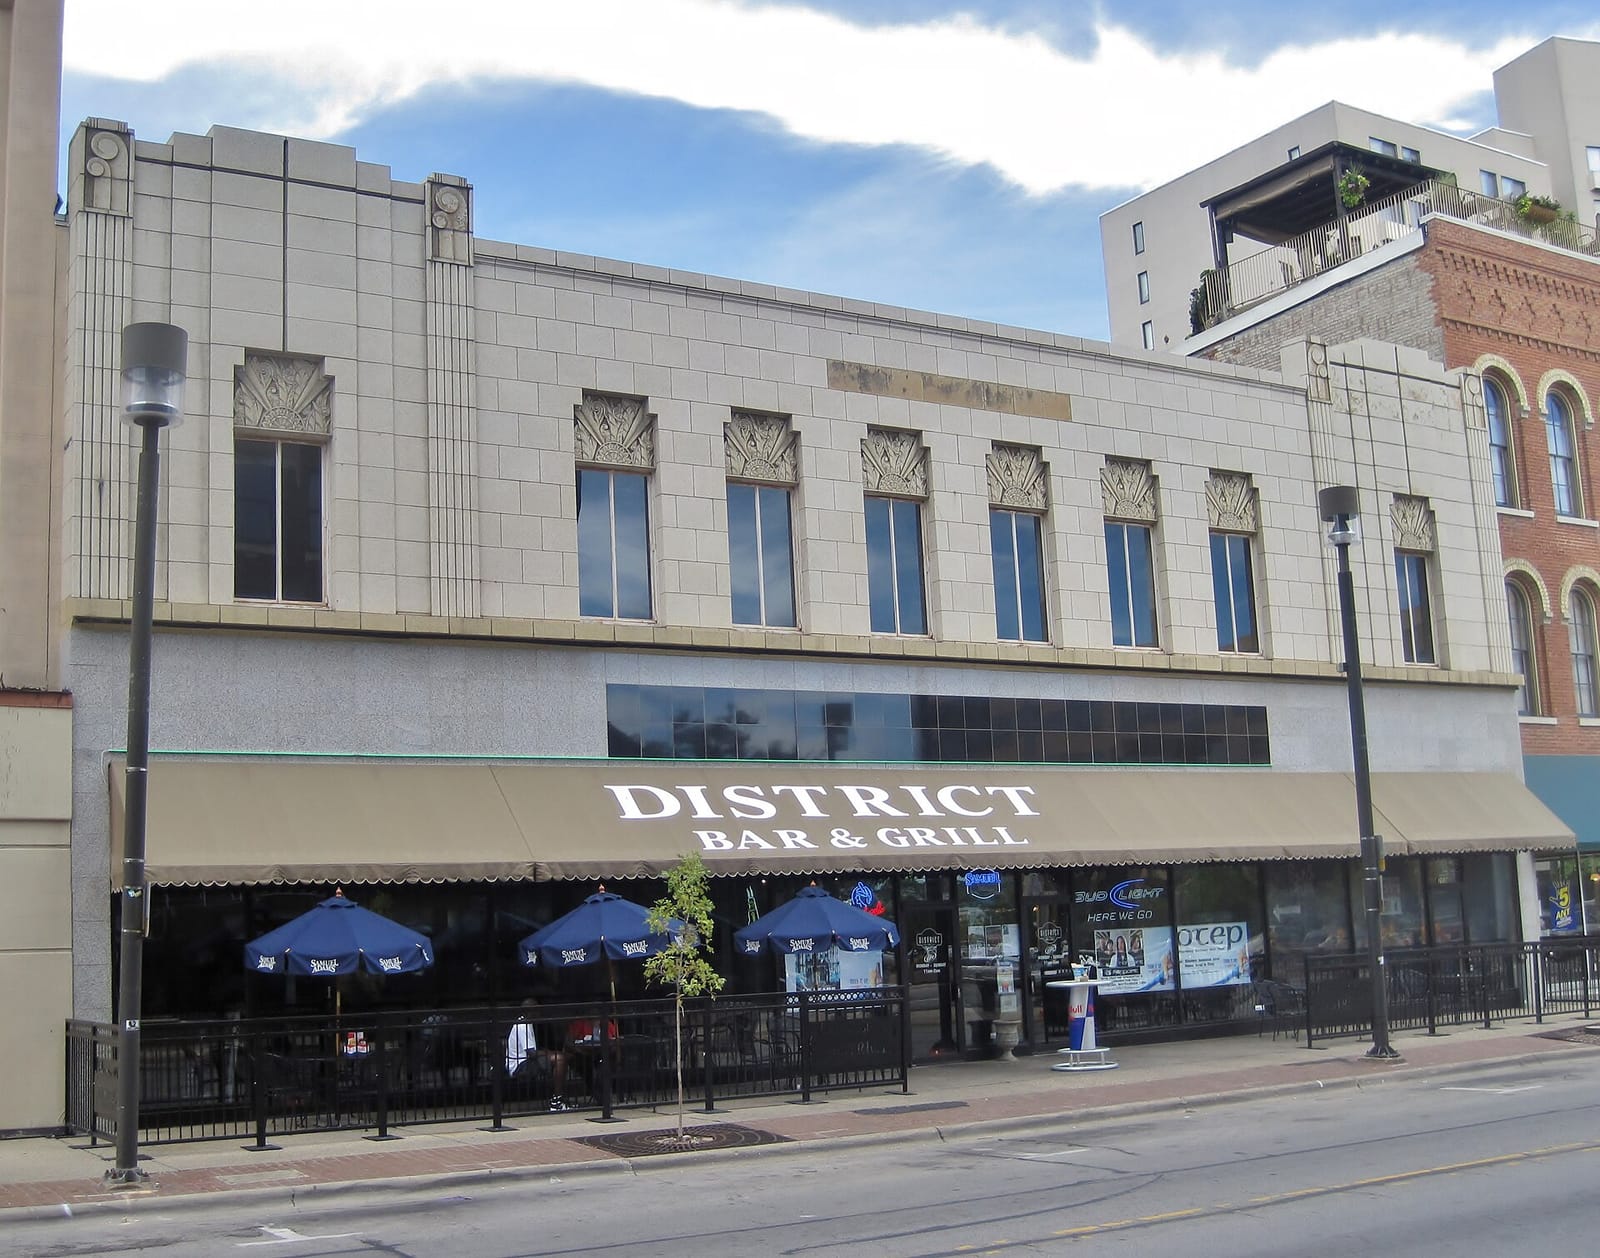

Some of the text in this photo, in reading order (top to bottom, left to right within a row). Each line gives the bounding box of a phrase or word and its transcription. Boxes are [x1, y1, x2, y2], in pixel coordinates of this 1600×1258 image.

[603, 784, 1041, 820] DISTRICT
[692, 826, 1030, 851] BAR & GRILL
[1075, 887, 1164, 904] BUD LIGHT
[1559, 886, 1570, 907] 5
[1087, 909, 1153, 923] HERE WE GO
[790, 938, 815, 948] SAMUEL
[918, 935, 940, 944] DISTRICT
[622, 940, 649, 951] SAMUEL
[561, 949, 587, 959] SAMUEL
[310, 958, 340, 967] SAMUEL
[311, 965, 337, 974] ADAMS
